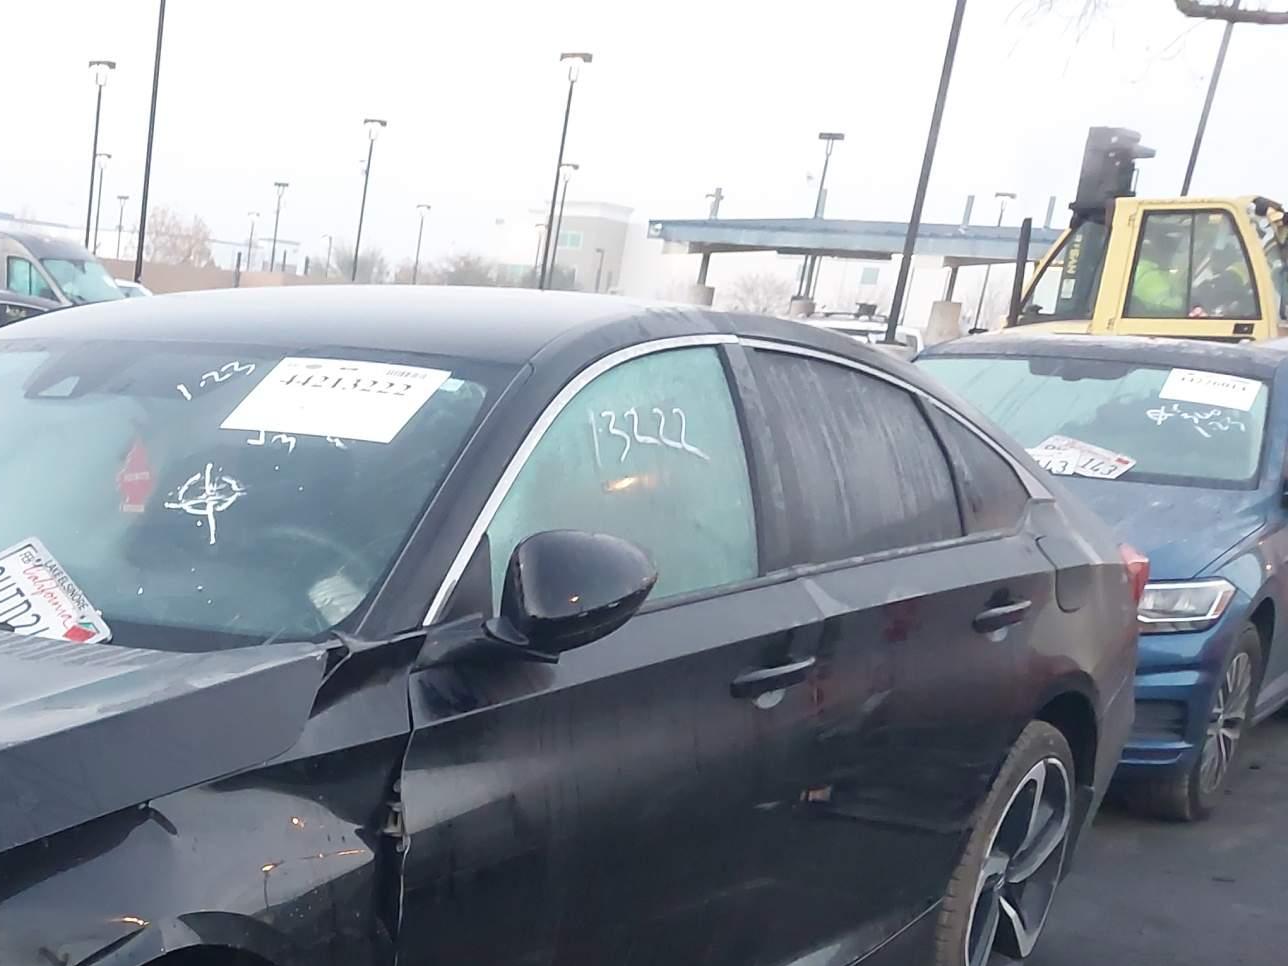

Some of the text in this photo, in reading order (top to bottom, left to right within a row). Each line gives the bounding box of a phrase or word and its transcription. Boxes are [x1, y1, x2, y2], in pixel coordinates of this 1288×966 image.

[280, 374, 412, 397] 44213222
[589, 407, 711, 468] 13222
[23, 562, 73, 630] California
[44, 559, 89, 611] LAKE ELSINORE
